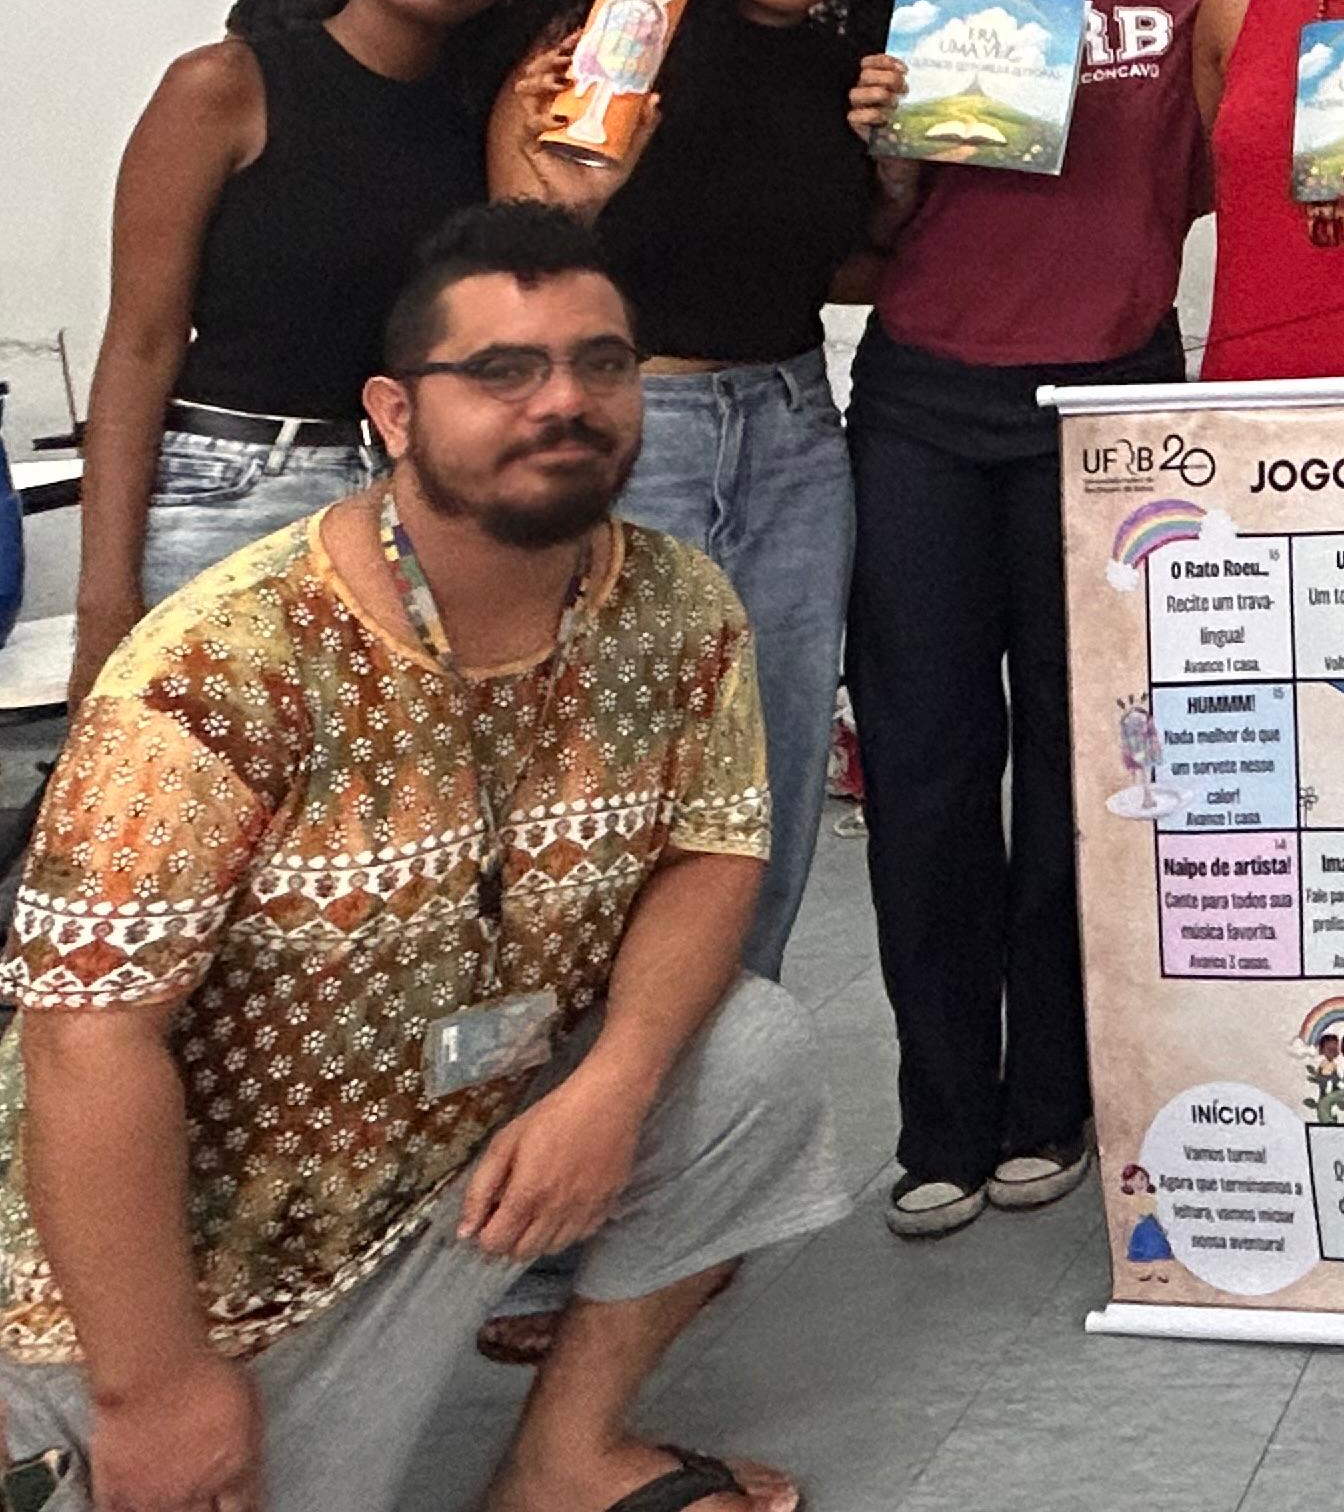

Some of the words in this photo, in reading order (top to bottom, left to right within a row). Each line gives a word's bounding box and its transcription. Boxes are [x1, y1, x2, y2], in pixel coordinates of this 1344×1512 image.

[1158, 433, 1216, 487] 20
[1171, 561, 1181, 579] O
[1185, 561, 1219, 579] Rato
[1167, 594, 1209, 613] Recite
[1212, 597, 1233, 611] um
[1309, 588, 1331, 605] Um
[1163, 857, 1207, 879] Naipe
[1211, 857, 1230, 877] de
[1234, 855, 1291, 876] artista!
[1191, 1099, 1265, 1126] INÍCIO!
